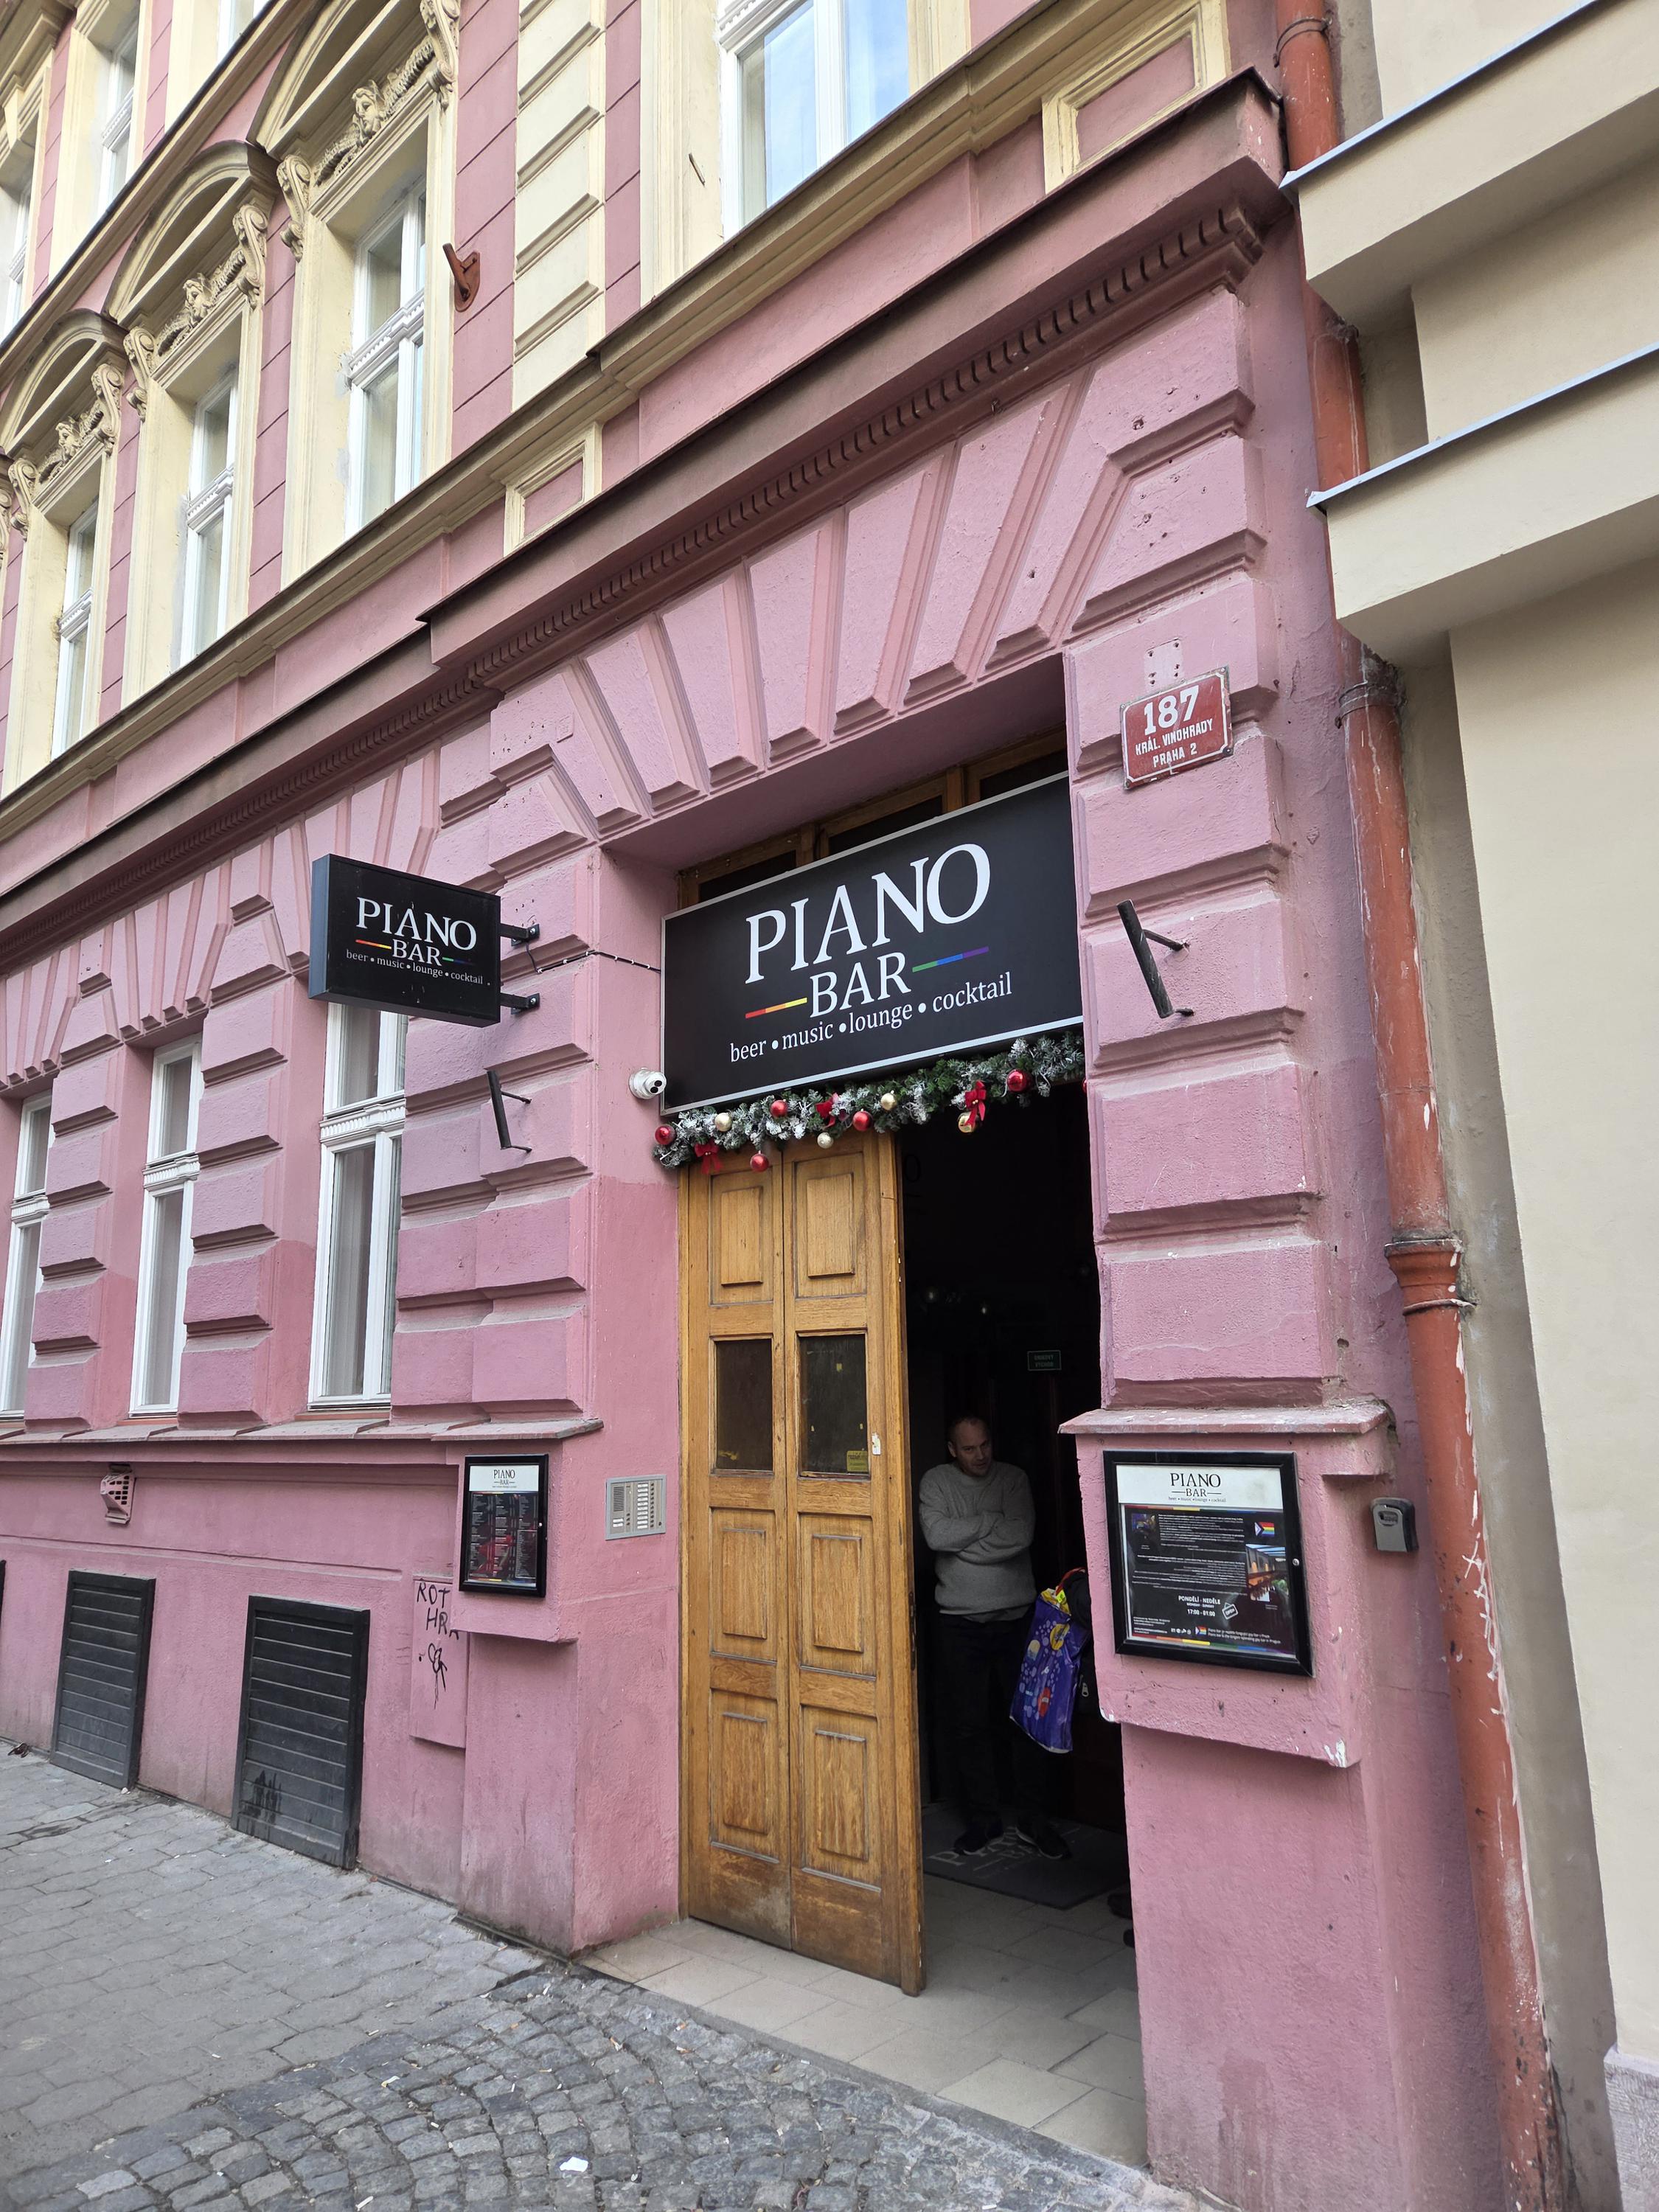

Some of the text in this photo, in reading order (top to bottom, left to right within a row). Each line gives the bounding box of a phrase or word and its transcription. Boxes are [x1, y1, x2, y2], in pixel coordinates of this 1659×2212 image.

[1144, 684, 1199, 736] 187
[1135, 718, 1214, 756] KRÁL. VINOHRADY
[1152, 742, 1197, 768] PRAHA 2
[355, 897, 478, 951] PIANO
[745, 843, 991, 985] PIANO
[346, 949, 484, 984] beer music lounge cocktail
[392, 938, 442, 967] BAR
[809, 951, 912, 1018] BAR
[729, 971, 1013, 1063] beer music lounge cocktail
[493, 1469, 516, 1479] PIANO
[1169, 1472, 1222, 1488] PIANO
[1186, 1488, 1207, 1498] BAR
